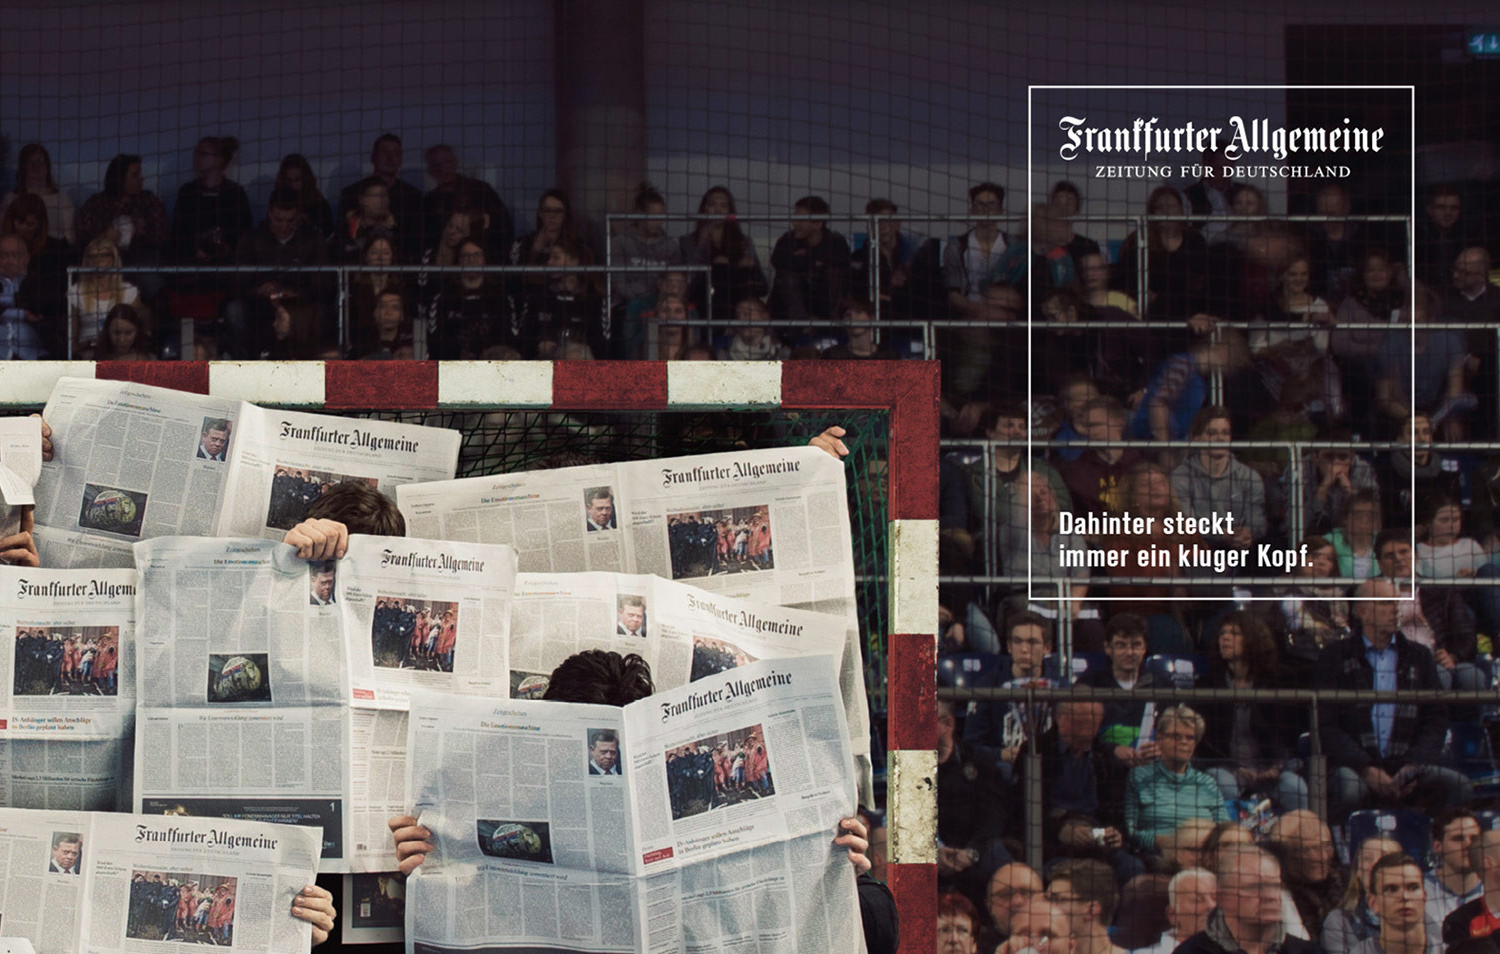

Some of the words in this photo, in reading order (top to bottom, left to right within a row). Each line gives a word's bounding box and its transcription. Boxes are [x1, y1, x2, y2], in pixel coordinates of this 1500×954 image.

[280, 421, 350, 443] Frankfurter
[350, 429, 419, 453] Allgemeine
[662, 466, 732, 488] Frankfurter
[733, 458, 801, 481] Allgemeine
[381, 548, 437, 571] Frankfurter
[438, 549, 486, 574] Allgemeine
[17, 579, 88, 599] Frankfurter
[687, 594, 738, 624] Frankfurter
[738, 611, 803, 636] Allgemeine
[660, 691, 724, 724] Frankfurter
[725, 670, 792, 703] Allgemeine
[135, 825, 207, 844] Frankfurter
[207, 829, 278, 850] Allgemeine
